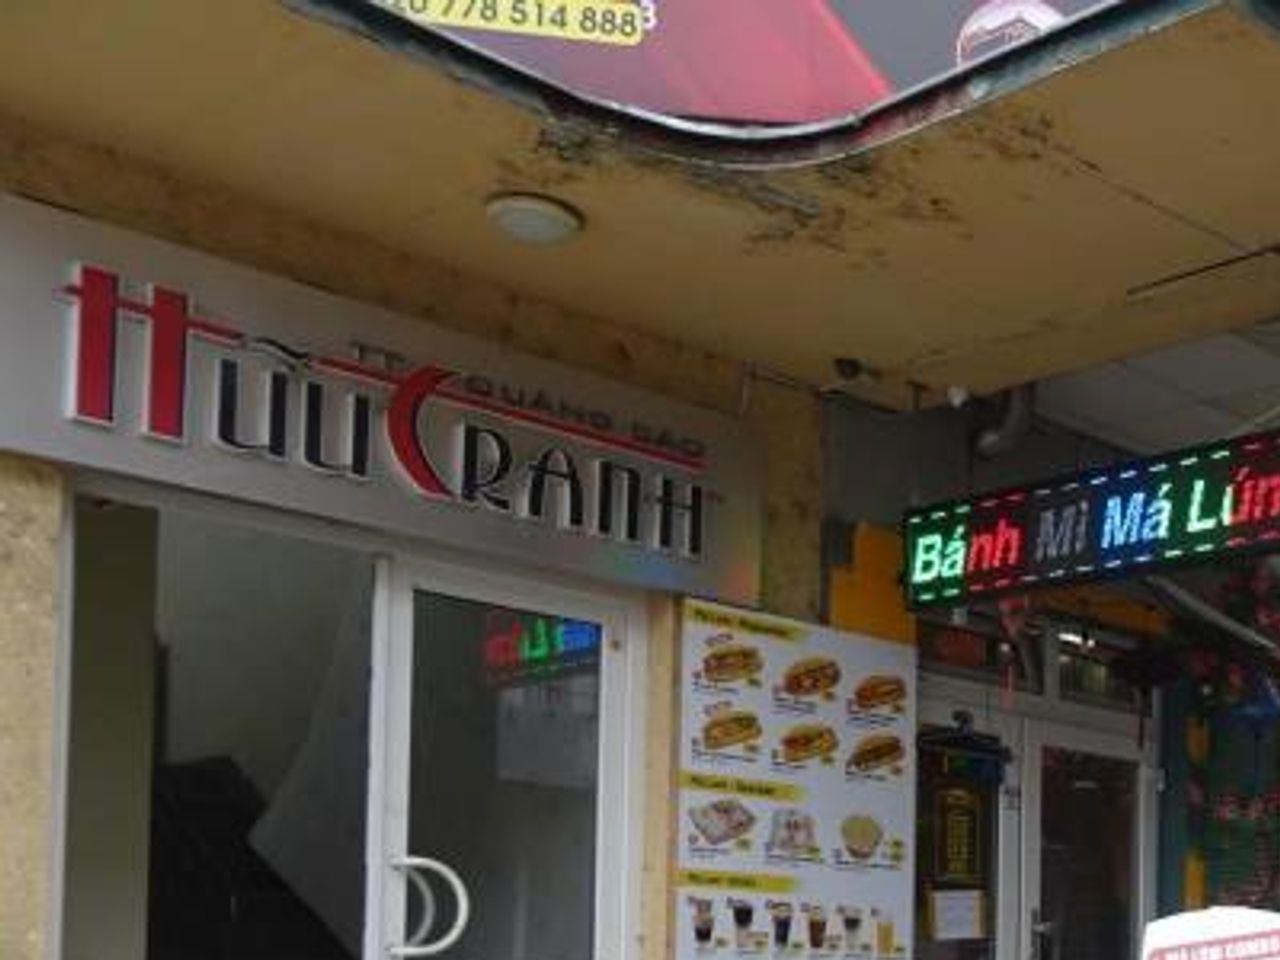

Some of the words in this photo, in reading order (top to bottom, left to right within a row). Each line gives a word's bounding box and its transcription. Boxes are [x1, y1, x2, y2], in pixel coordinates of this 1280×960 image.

[509, 0, 568, 29] 514
[578, 7, 637, 37] 888
[1100, 483, 1172, 549] Má
